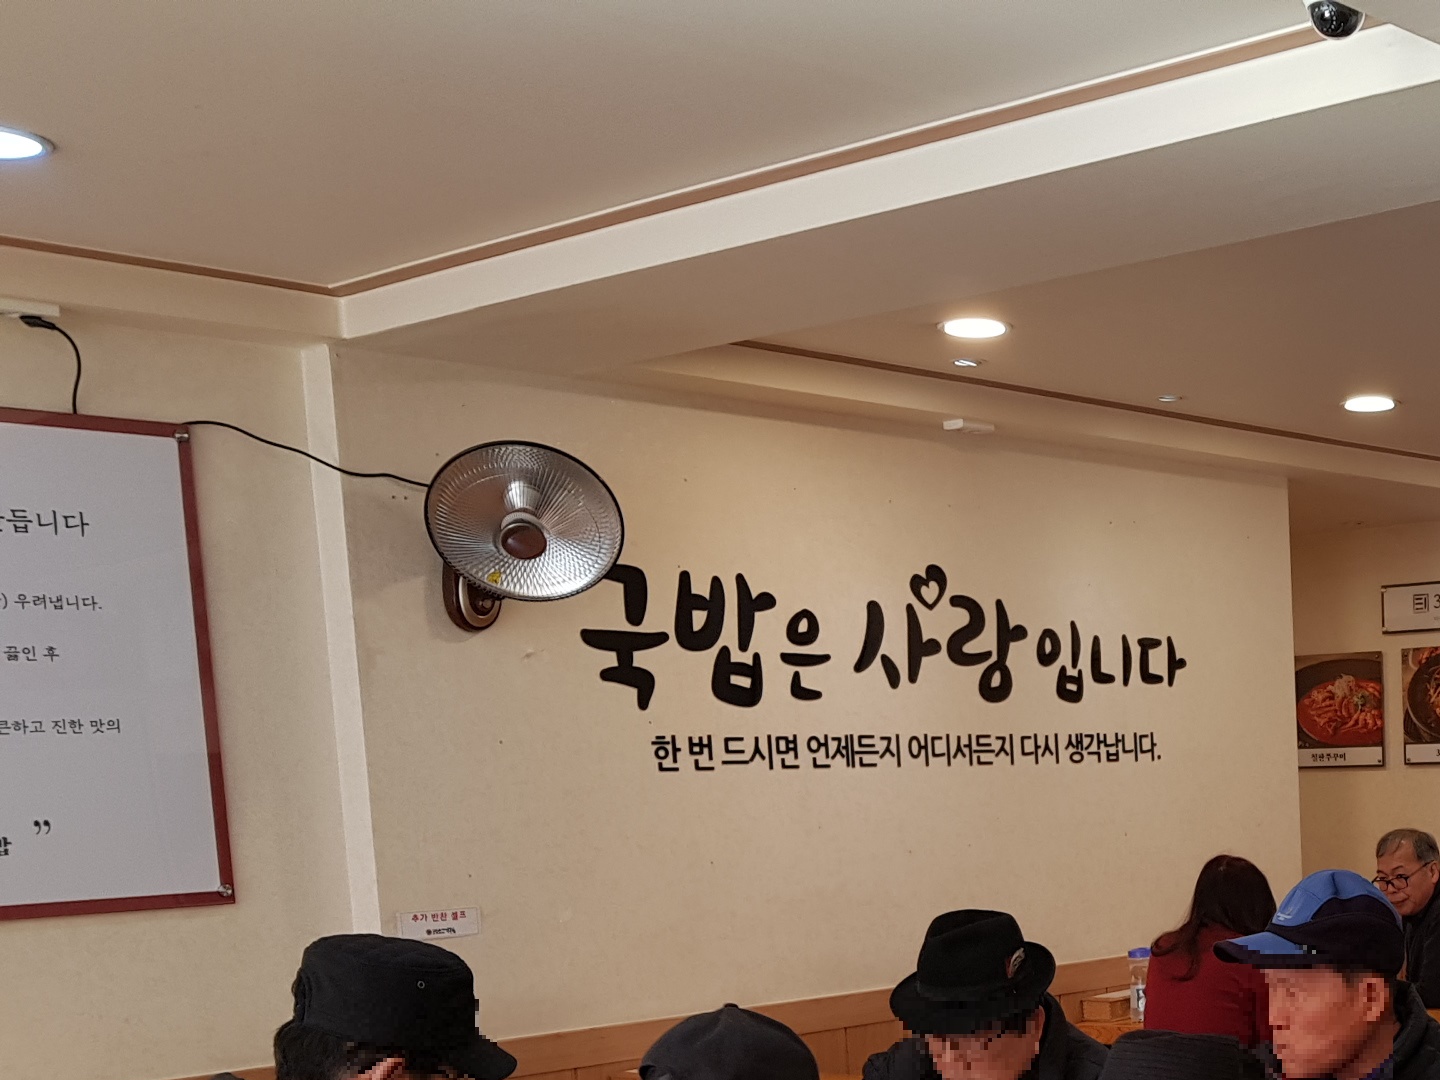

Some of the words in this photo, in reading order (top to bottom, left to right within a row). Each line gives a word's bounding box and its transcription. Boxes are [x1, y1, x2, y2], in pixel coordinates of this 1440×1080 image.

[0, 508, 90, 538] 듭니다
[14, 593, 103, 612] 우려냅니다.
[580, 563, 832, 711] 국밥은
[853, 585, 1188, 704] 사랑입니다
[43, 645, 60, 663] 후
[51, 718, 84, 735] 진한
[89, 718, 122, 735] 맛의
[650, 734, 683, 773] 한
[687, 734, 715, 771] 번
[720, 733, 801, 770] 드시면
[806, 733, 902, 769] 언제든지
[907, 732, 1015, 768] 어디서든지
[1020, 732, 1061, 765] 다시
[1065, 731, 1163, 764] 생각납니다.
[411, 913, 428, 923] 추가
[430, 912, 448, 922] 반찬
[450, 910, 467, 921] 셀프
